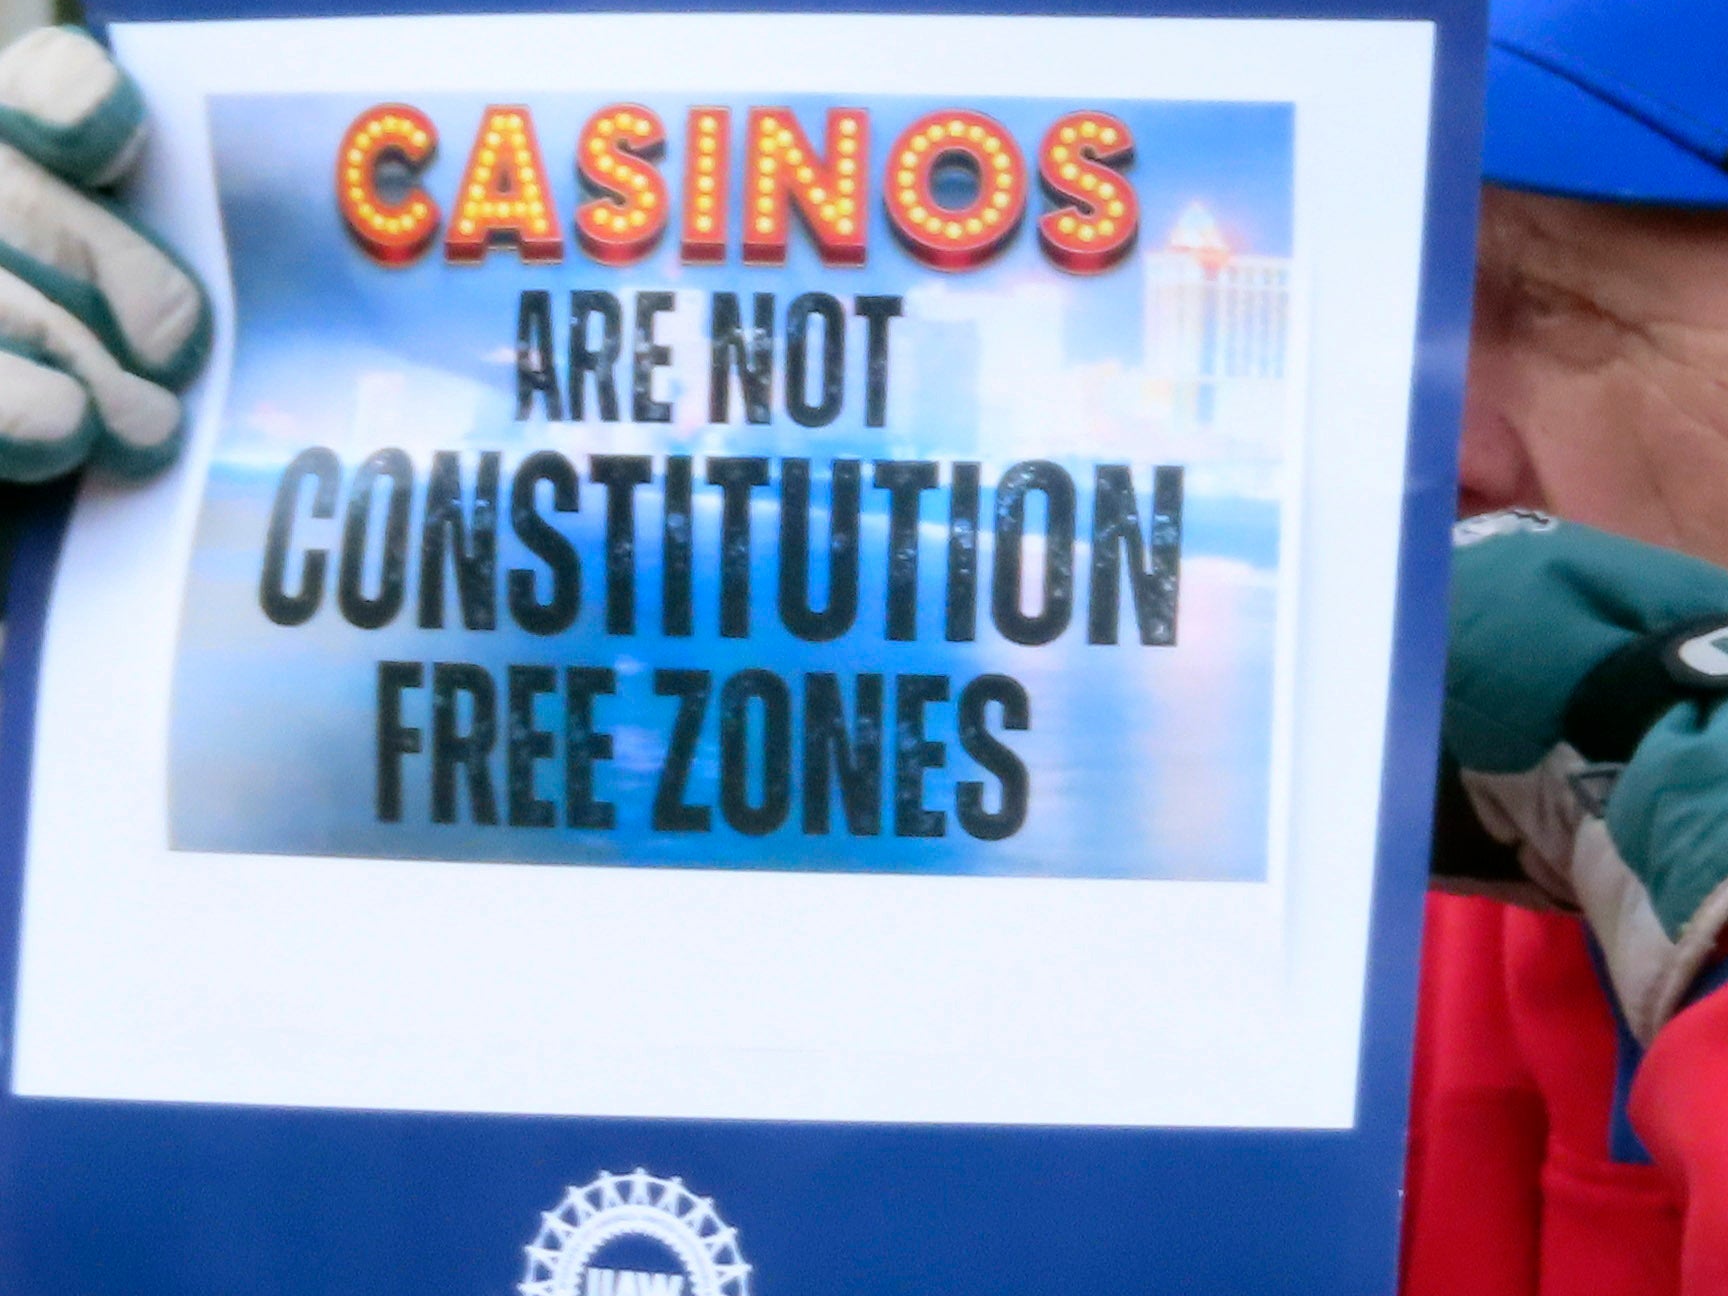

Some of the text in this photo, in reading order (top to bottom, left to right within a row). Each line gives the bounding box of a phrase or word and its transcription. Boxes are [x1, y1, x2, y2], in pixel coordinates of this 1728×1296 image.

[335, 101, 1142, 278] CASINOS
[514, 289, 904, 428] ARE NOT
[257, 446, 1185, 648] CONSTITUTION
[374, 659, 1033, 841] FREE ZONES
